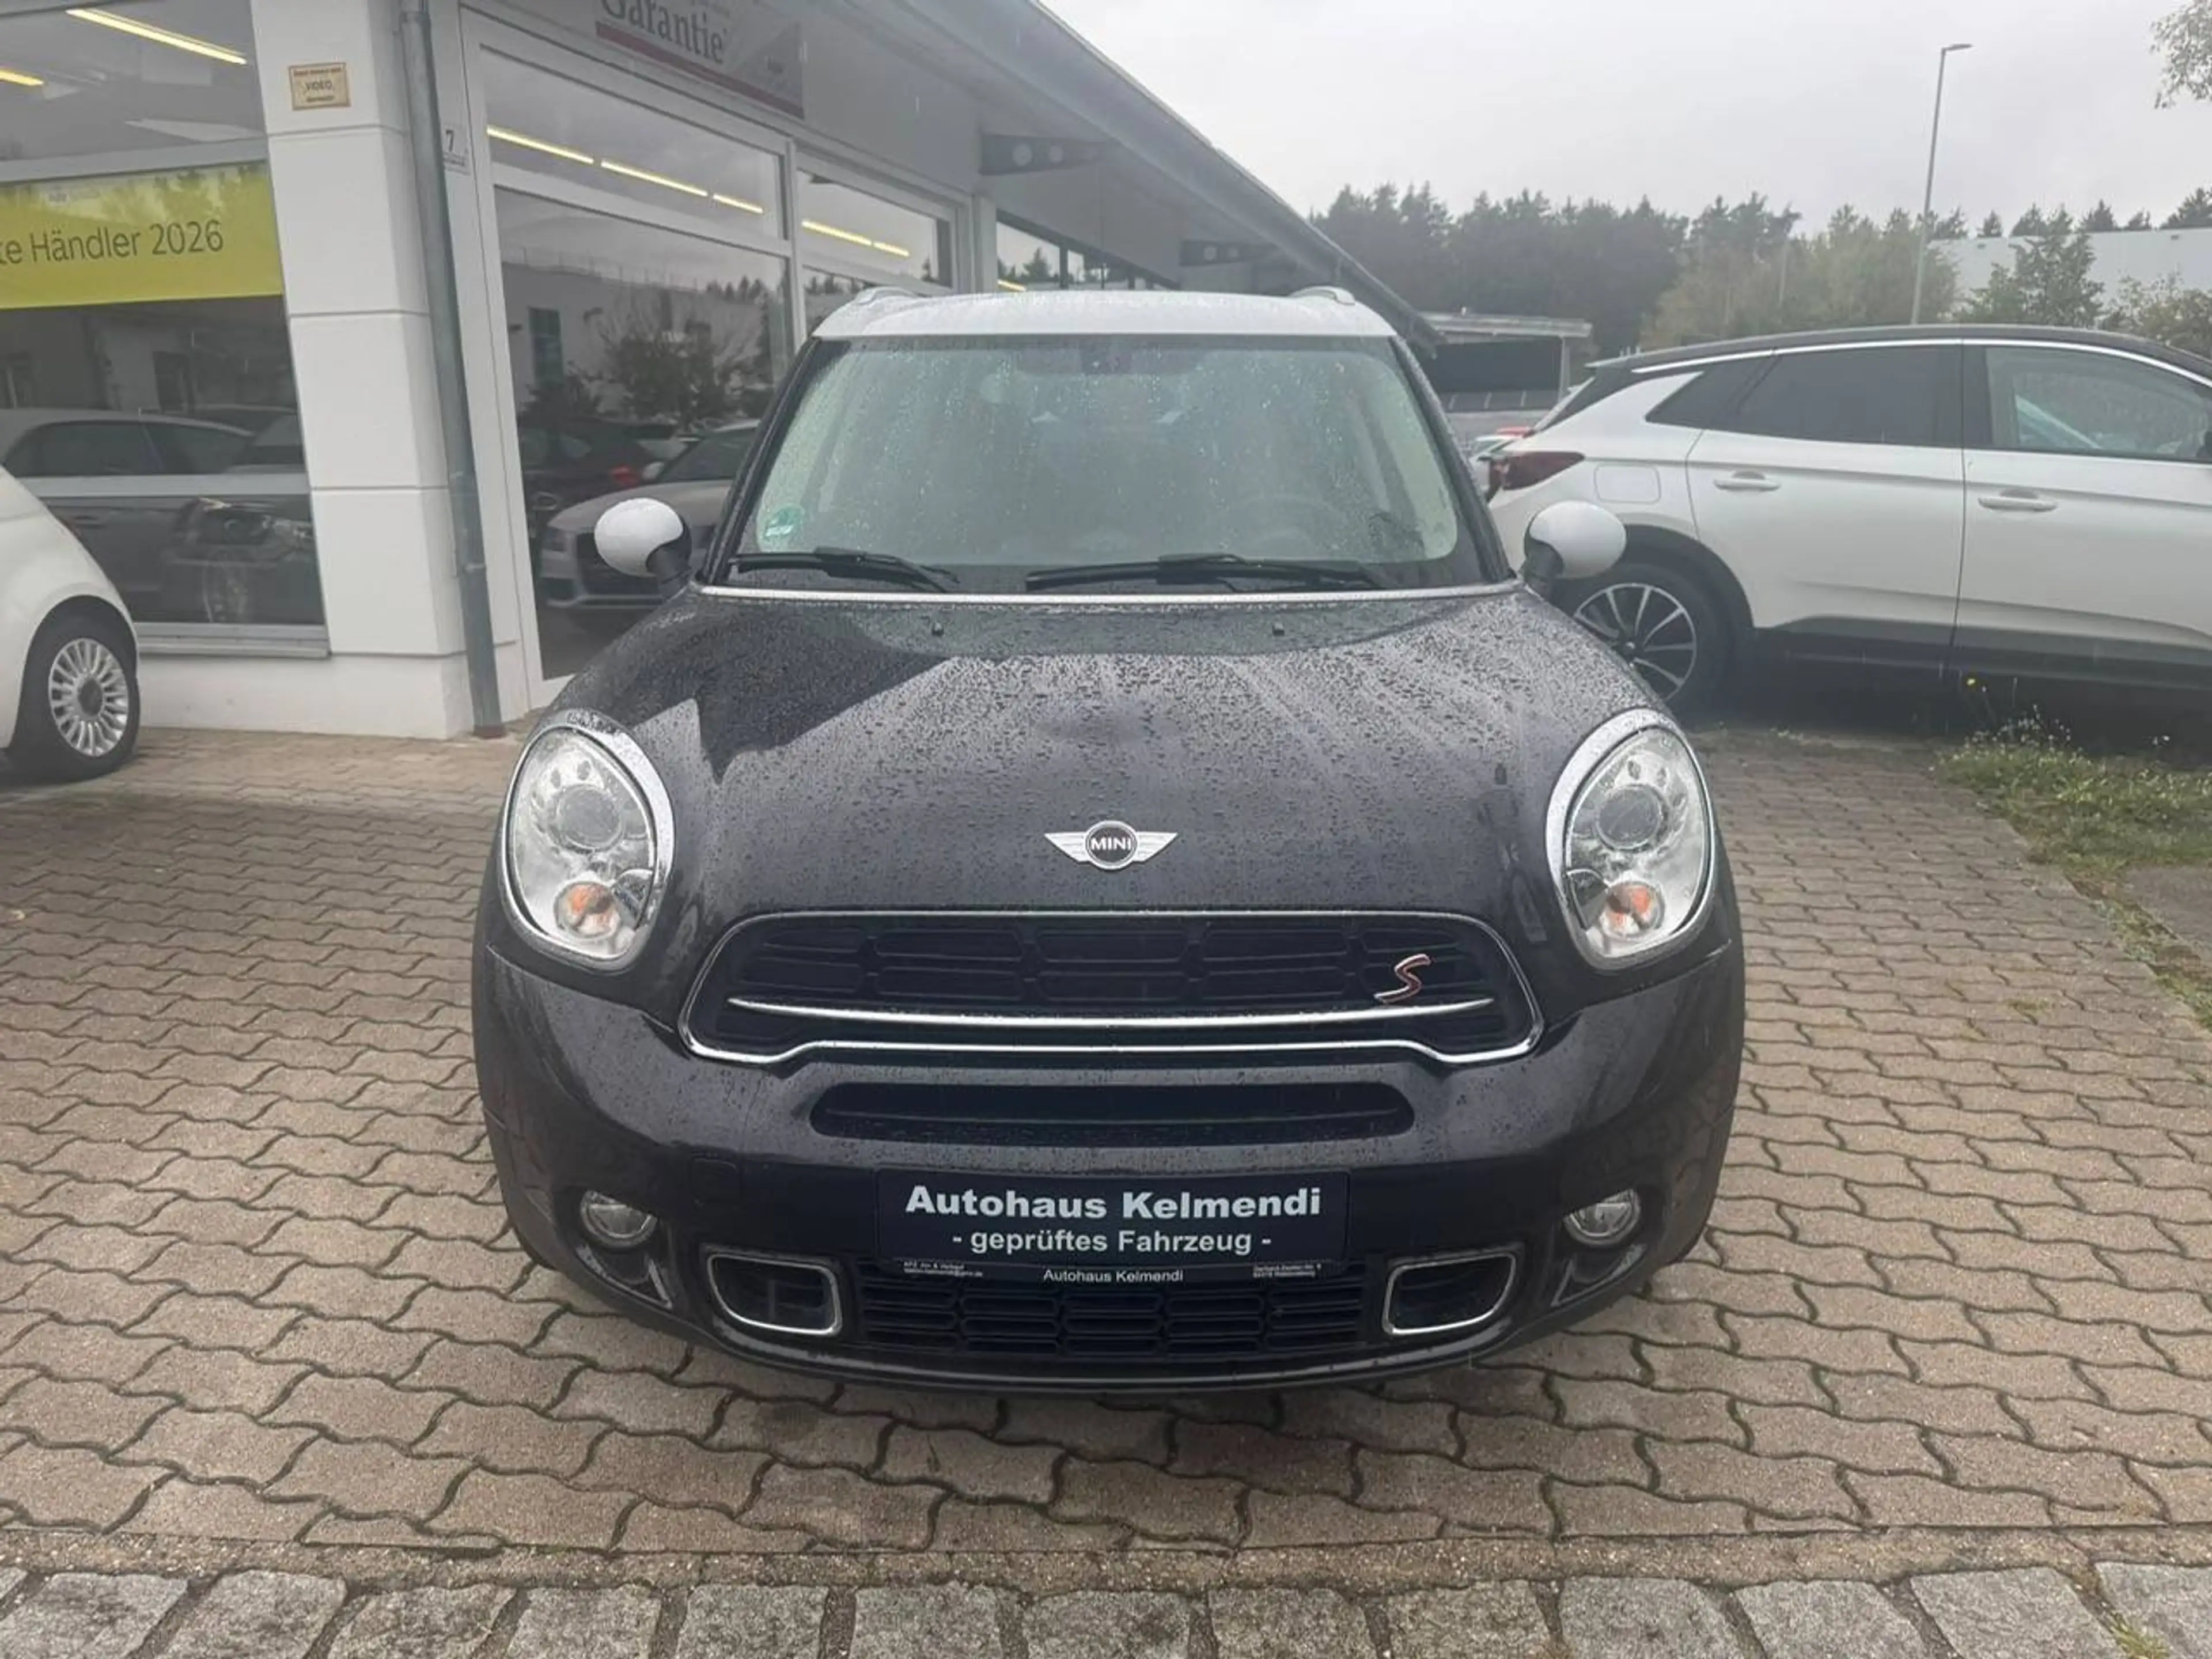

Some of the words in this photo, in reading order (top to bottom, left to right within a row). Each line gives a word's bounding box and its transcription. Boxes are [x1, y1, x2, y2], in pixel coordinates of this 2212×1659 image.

[445, 129, 454, 152] 7
[29, 227, 141, 263] Händler
[149, 219, 224, 255] 2026
[1090, 837, 1131, 850] MINI
[1373, 953, 1431, 1005] S
[905, 1185, 1108, 1219] Autohaus
[1123, 1187, 1321, 1219] Kelmendi
[970, 1229, 1108, 1255] geprüftes
[1118, 1230, 1252, 1255] Fahrzeug
[1043, 1269, 1112, 1283] Autohaus
[1116, 1269, 1184, 1283] Kelmendi
